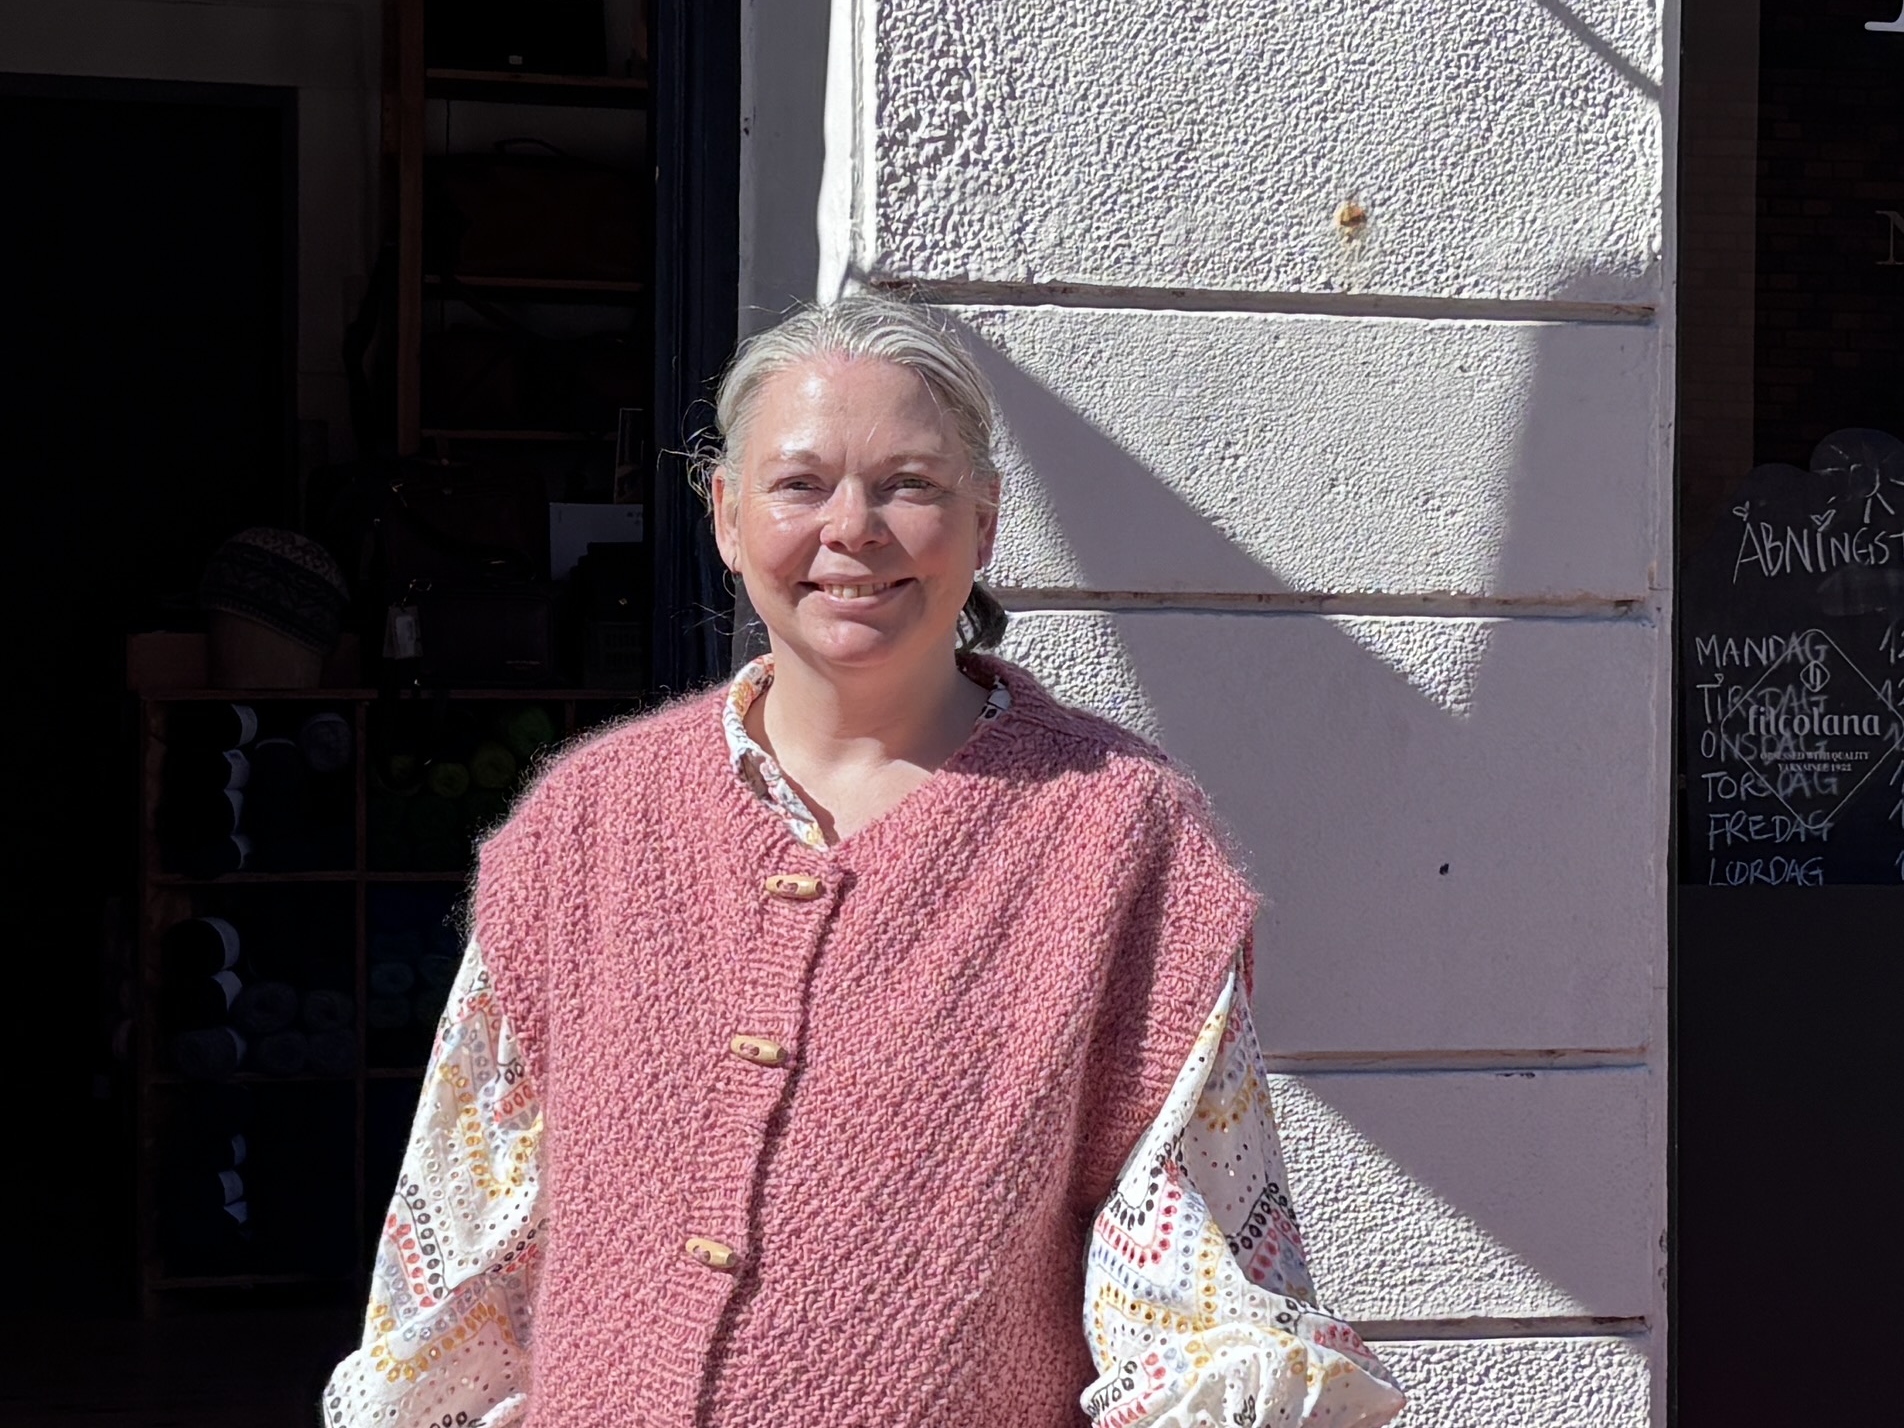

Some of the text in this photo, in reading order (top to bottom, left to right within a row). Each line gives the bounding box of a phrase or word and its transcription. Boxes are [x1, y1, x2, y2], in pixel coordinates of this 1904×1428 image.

[1695, 631, 1829, 669] MANDAG
[1747, 704, 1881, 736] filcolana
[1707, 809, 1835, 852] FREDAG
